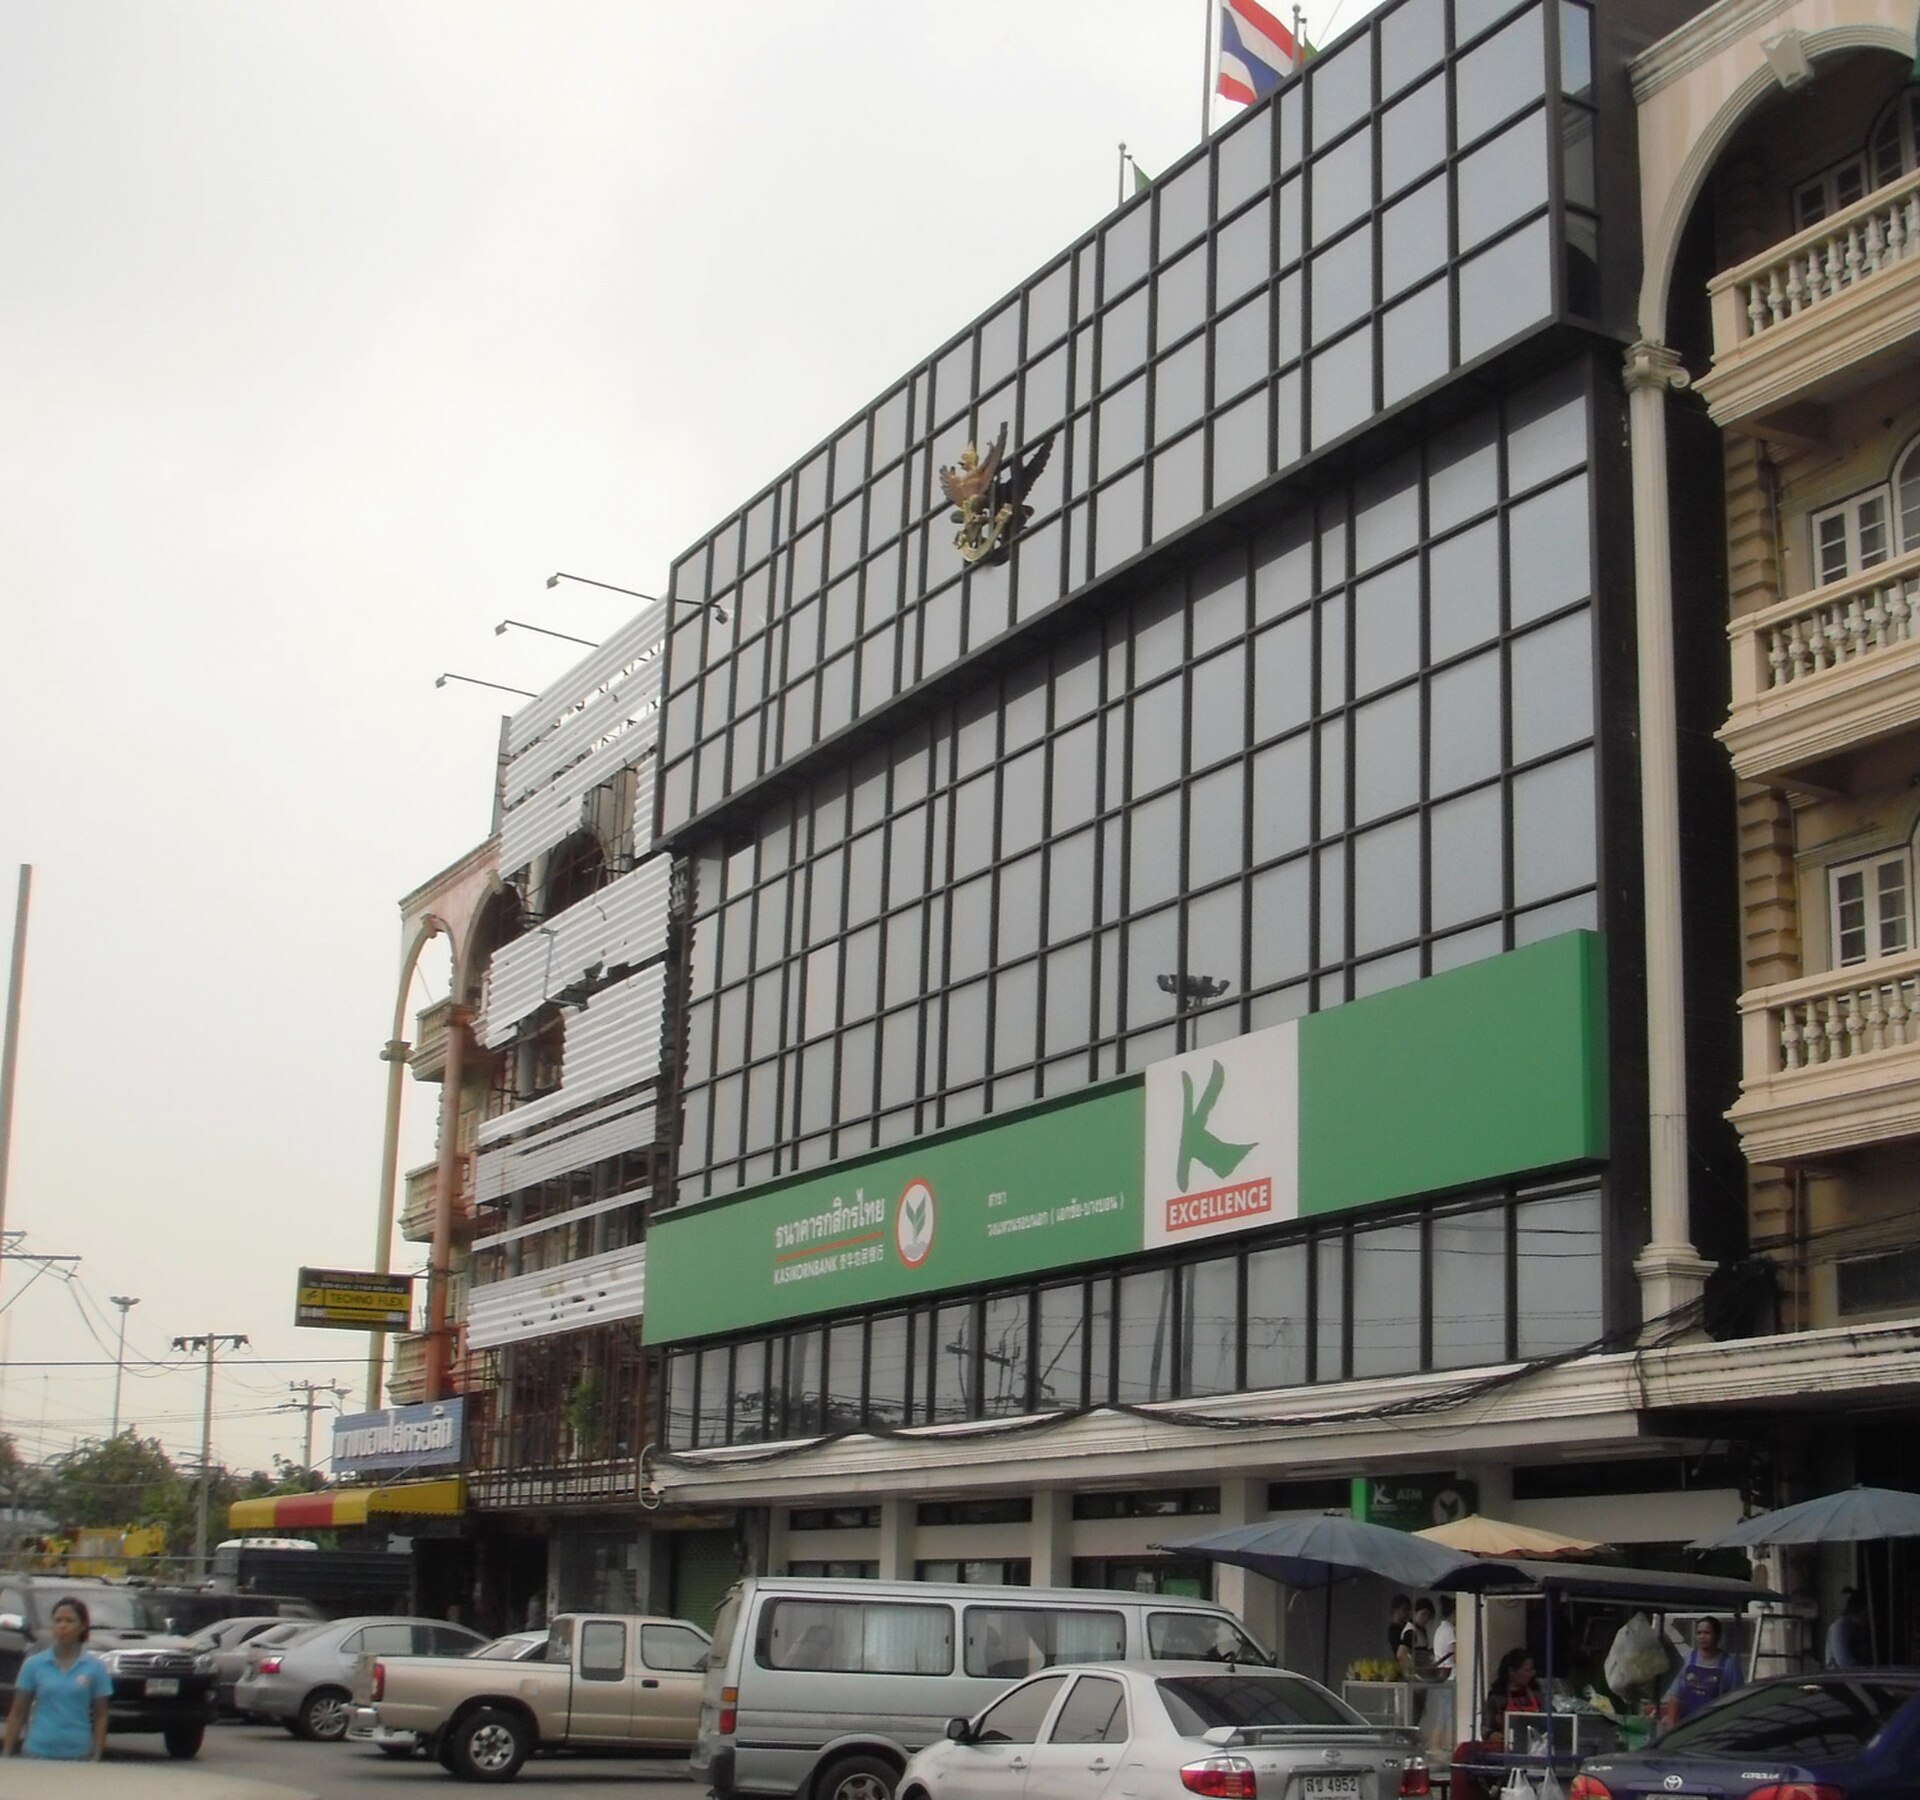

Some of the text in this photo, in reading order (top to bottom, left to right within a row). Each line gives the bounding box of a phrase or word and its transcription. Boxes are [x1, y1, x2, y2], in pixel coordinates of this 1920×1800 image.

[1169, 1184, 1268, 1226] EXCELLENCE
[775, 1187, 886, 1249] ธนาคารกสิกรไทย
[773, 1254, 838, 1285] KASIKORNBANK
[329, 1293, 405, 1308] TECHNO FLEX
[1397, 1487, 1423, 1501] ATM
[1327, 1777, 1358, 1793] 4952
